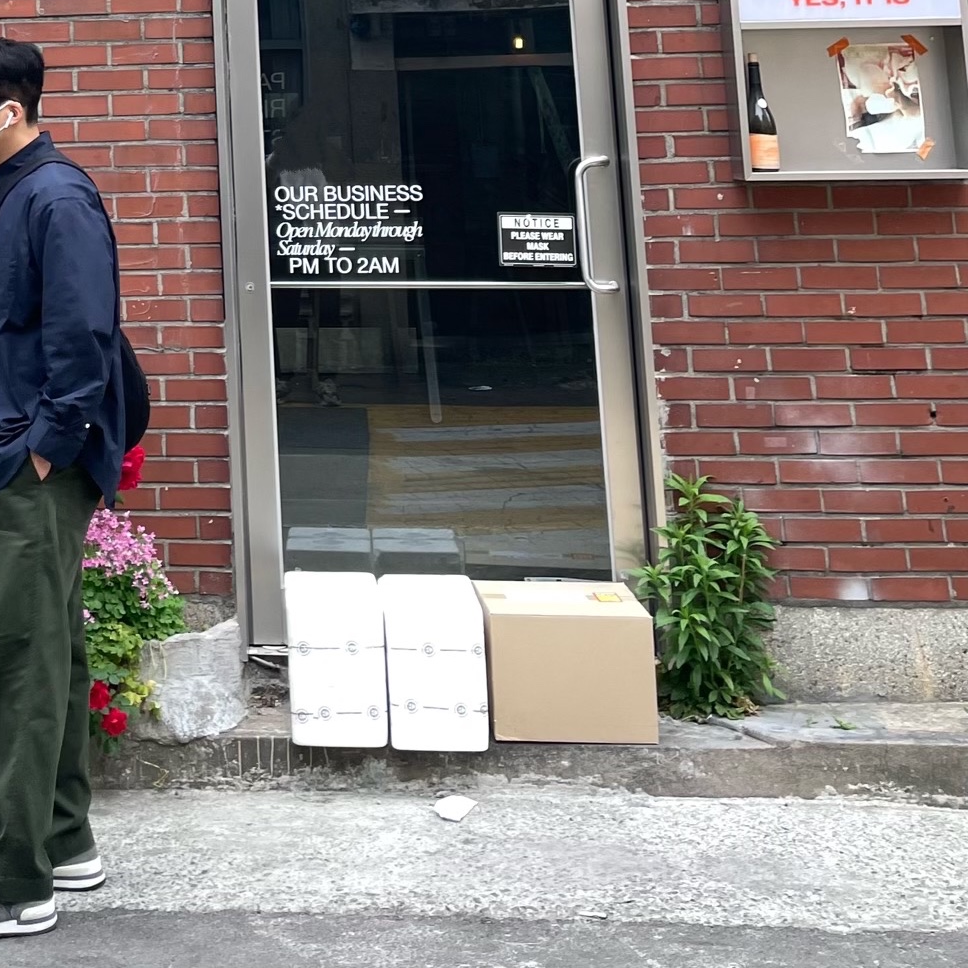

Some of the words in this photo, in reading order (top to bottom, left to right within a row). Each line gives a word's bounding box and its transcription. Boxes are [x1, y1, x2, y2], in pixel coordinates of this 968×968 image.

[274, 185, 318, 202] OUR
[323, 184, 424, 202] BUSINESS
[514, 218, 559, 228] NOTICE
[276, 221, 314, 243] Open
[510, 231, 540, 240] PLEASE
[540, 232, 564, 241] WEAR
[277, 240, 335, 258] Saturday
[526, 242, 550, 251] MASK
[503, 252, 534, 261] BEFORE
[534, 252, 574, 262] ENTERING
[289, 257, 320, 275] PM
[324, 257, 353, 274] TO
[357, 257, 400, 274] 2AM
